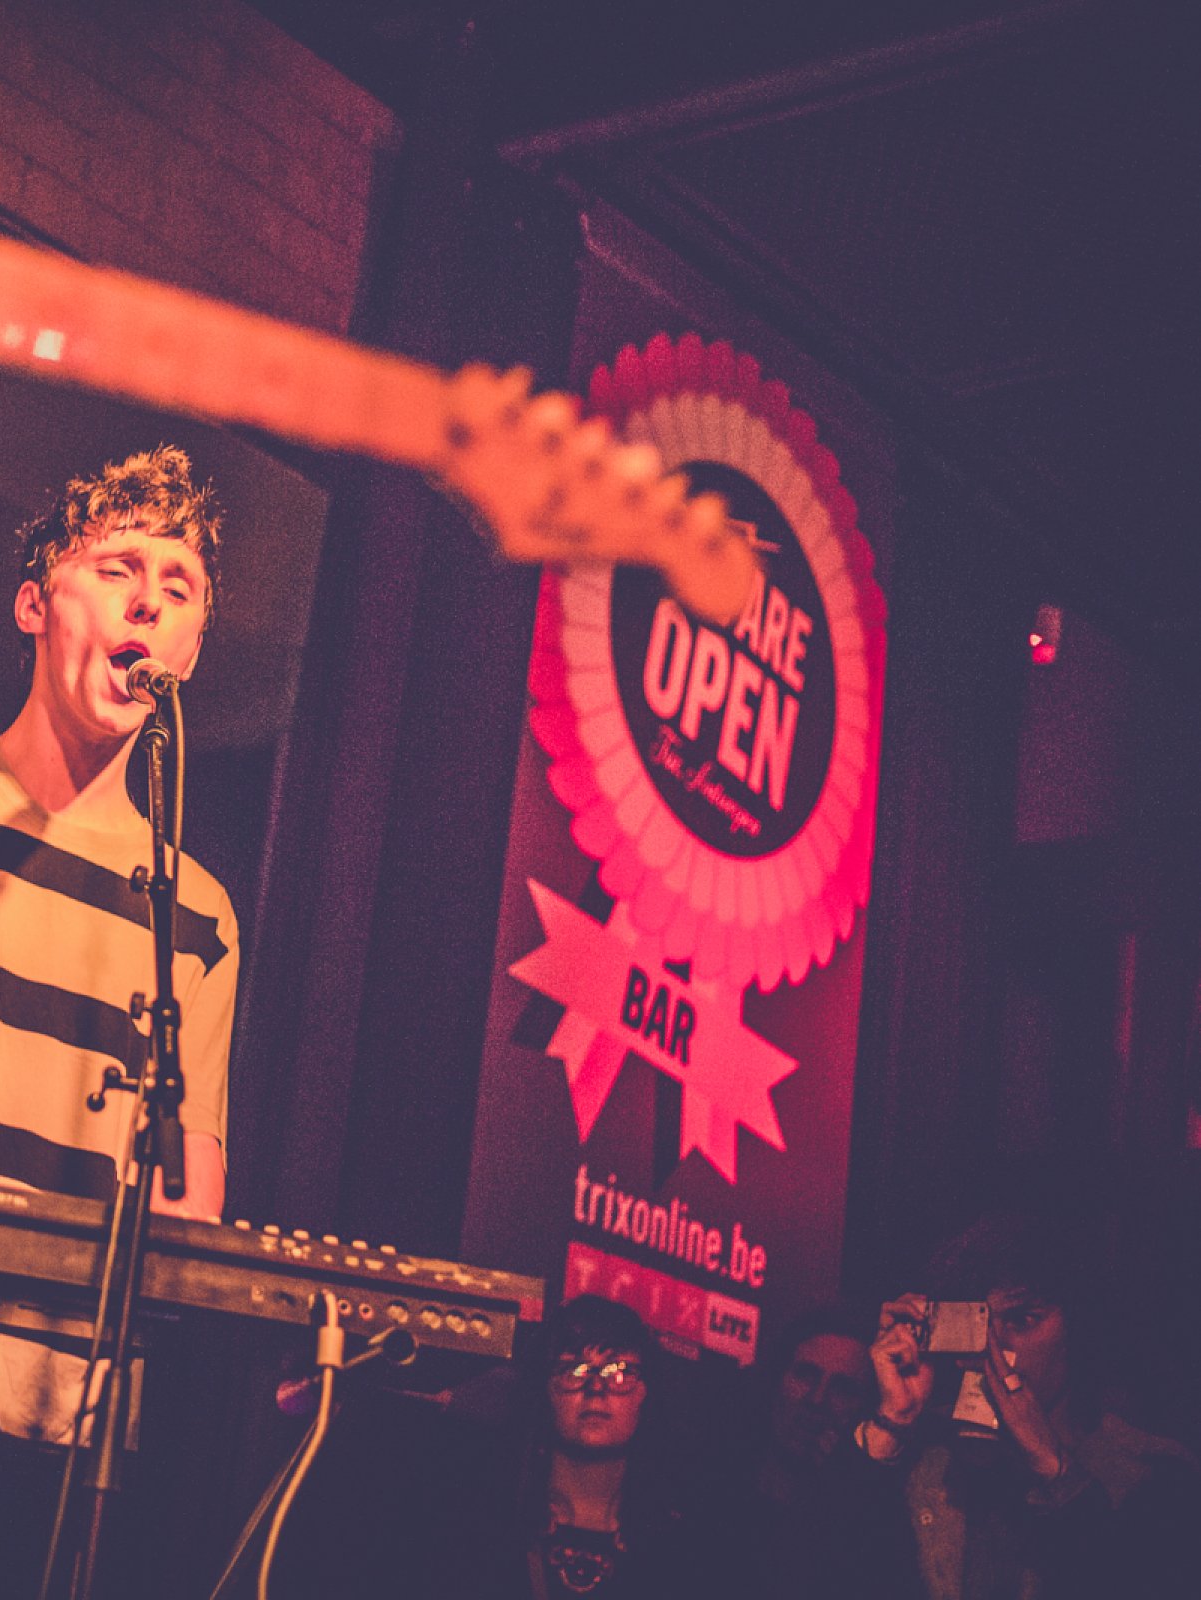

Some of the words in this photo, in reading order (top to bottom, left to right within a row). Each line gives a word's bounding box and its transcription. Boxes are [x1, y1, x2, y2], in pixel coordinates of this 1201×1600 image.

[734, 567, 813, 693] ARE
[643, 598, 799, 812] OPEN
[621, 965, 695, 1067] BAR
[574, 1163, 767, 1288] trixonline.be
